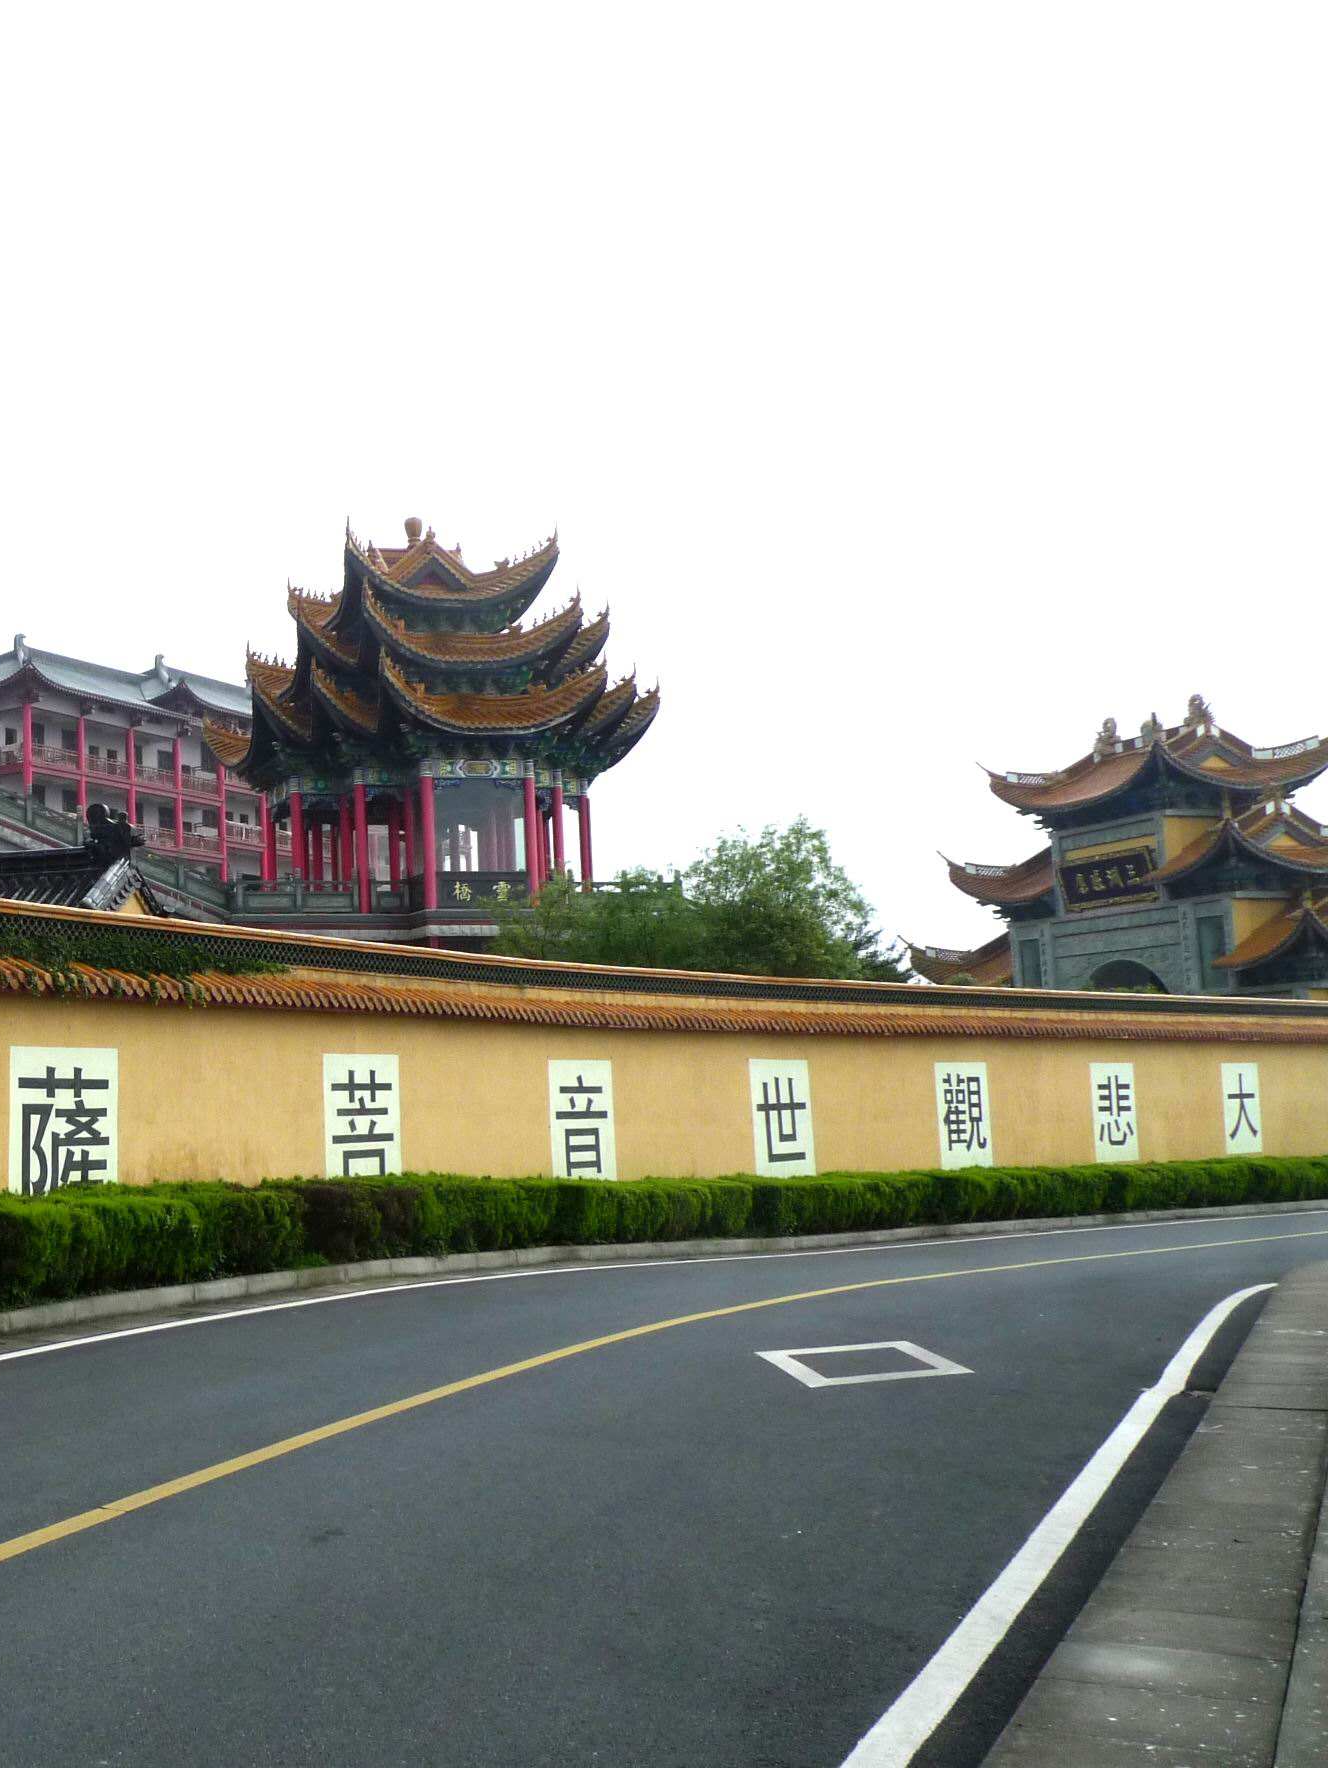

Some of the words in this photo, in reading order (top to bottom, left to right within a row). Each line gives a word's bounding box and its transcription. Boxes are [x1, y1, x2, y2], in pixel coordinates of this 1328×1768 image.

[18, 1066, 110, 1194] 薩
[331, 1070, 394, 1177] 菩
[555, 1075, 608, 1177] 音
[757, 1077, 806, 1163] 世
[943, 1074, 987, 1151] 觀
[1097, 1075, 1134, 1146] 悲
[1227, 1073, 1258, 1140] 大
